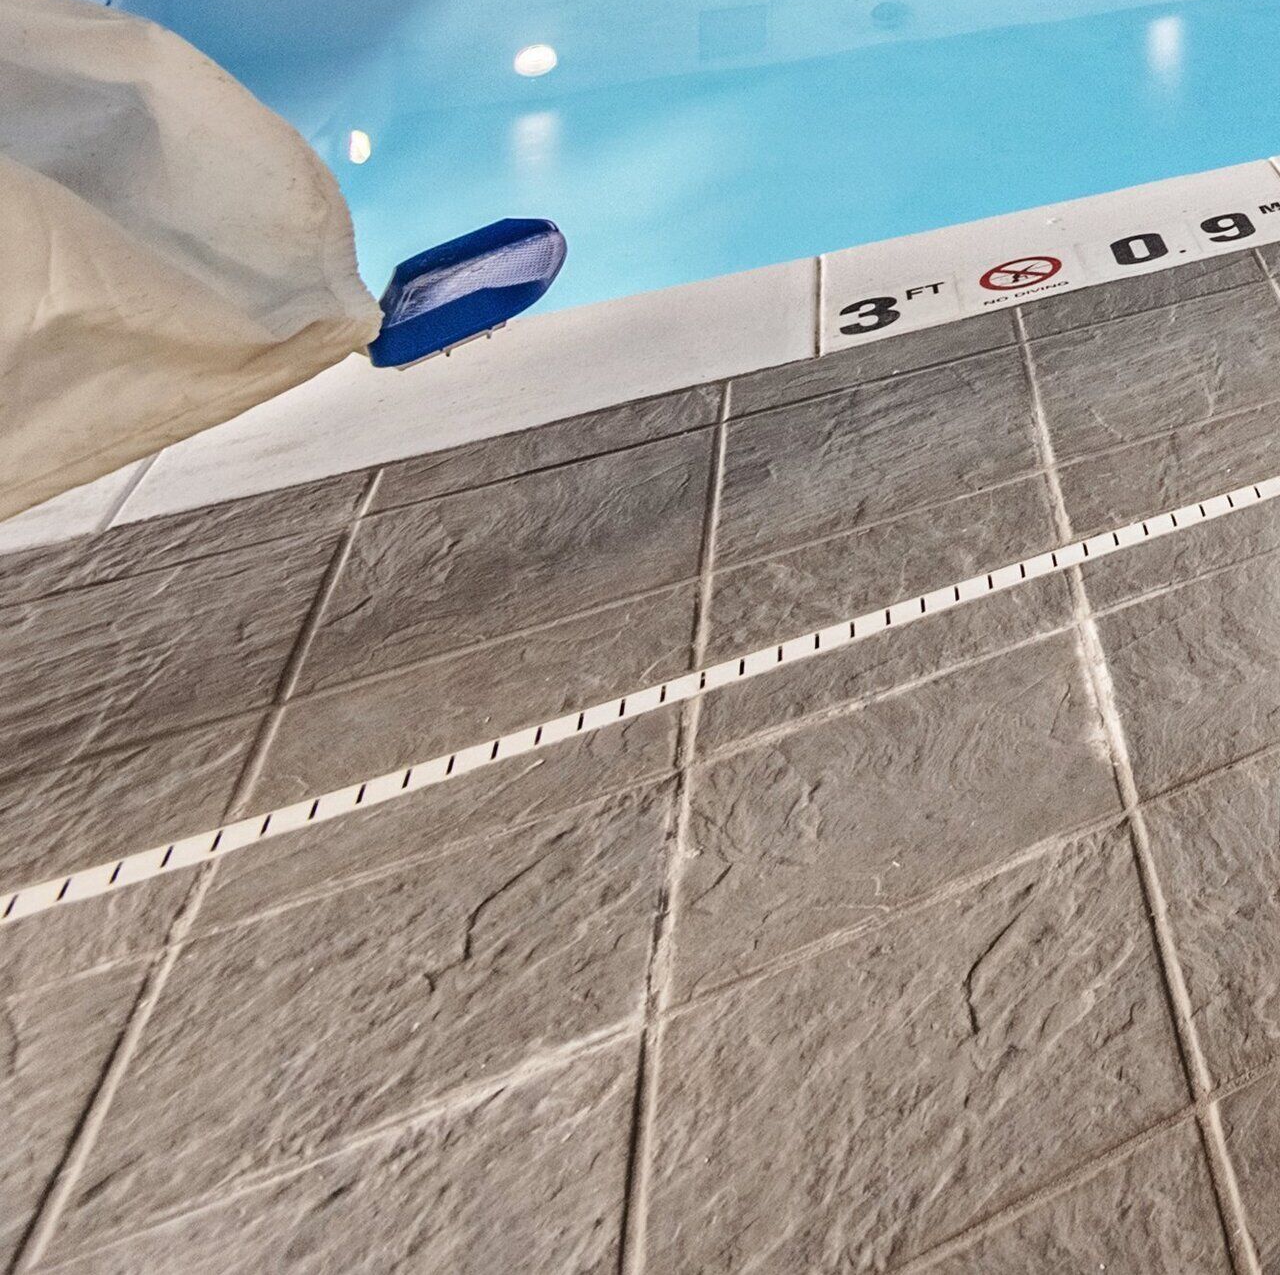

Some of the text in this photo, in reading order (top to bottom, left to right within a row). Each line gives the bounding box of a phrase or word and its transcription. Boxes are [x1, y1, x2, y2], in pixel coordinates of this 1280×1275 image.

[839, 296, 900, 335] 3
[906, 282, 944, 301] FT
[984, 280, 1070, 306] NO DIVING
